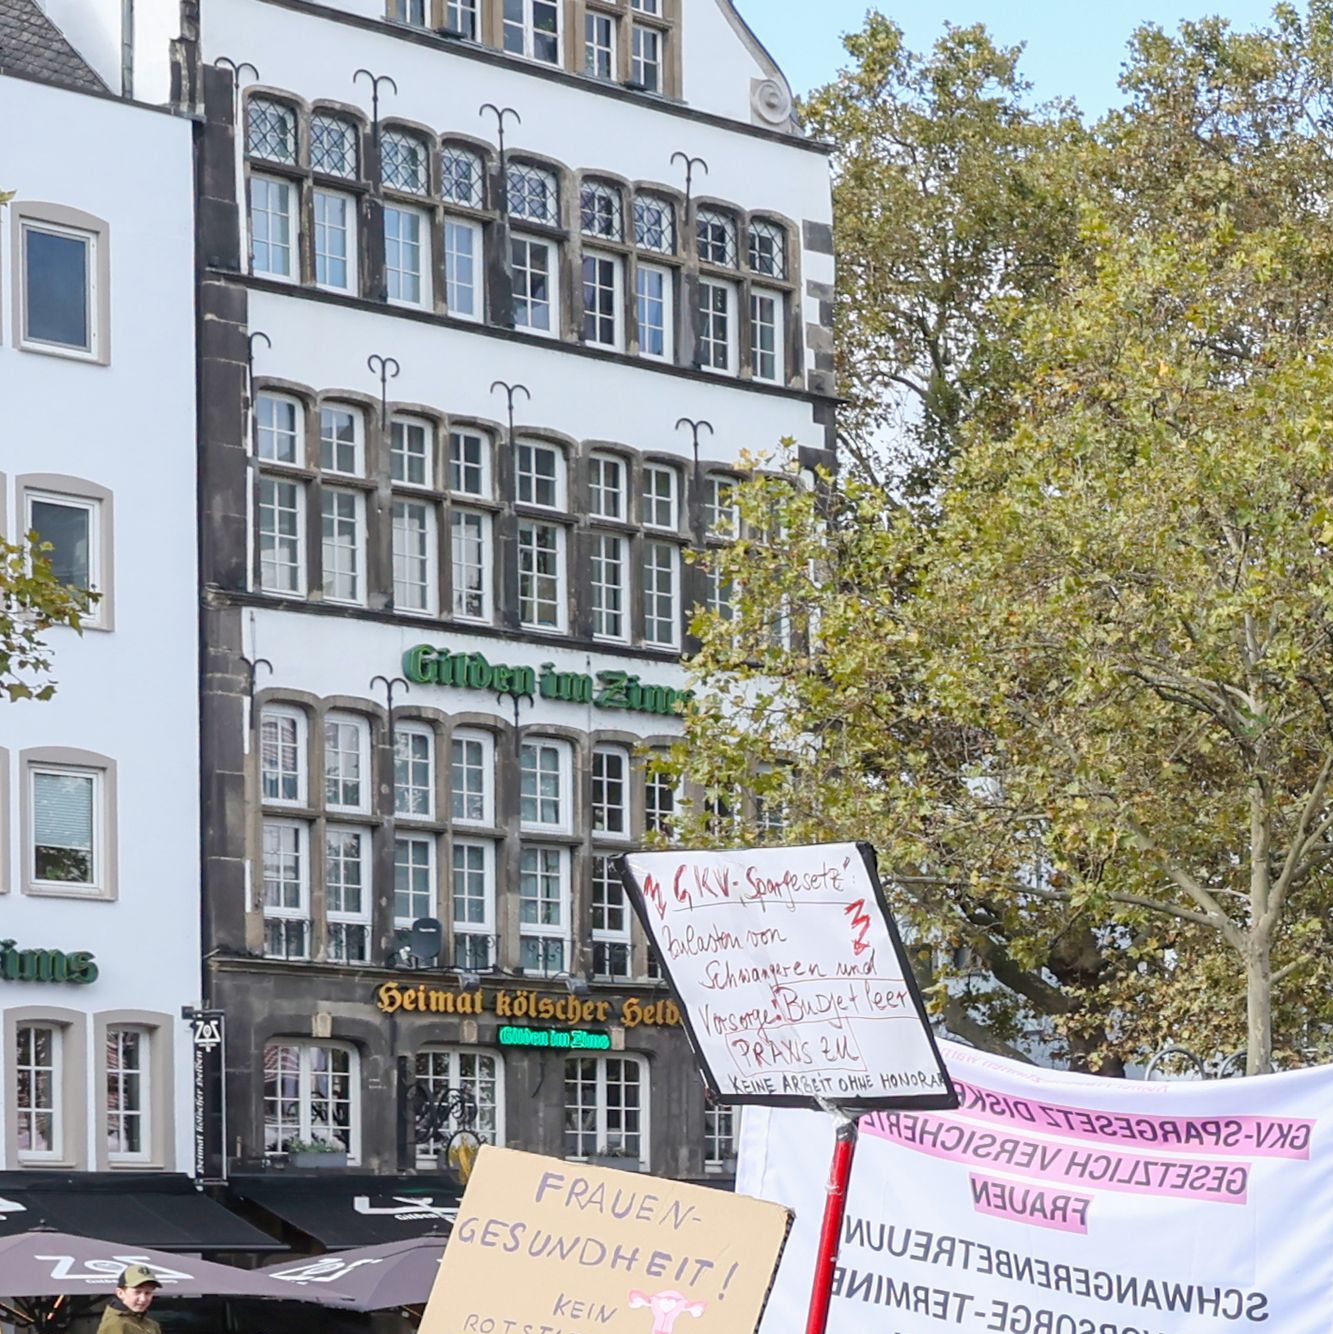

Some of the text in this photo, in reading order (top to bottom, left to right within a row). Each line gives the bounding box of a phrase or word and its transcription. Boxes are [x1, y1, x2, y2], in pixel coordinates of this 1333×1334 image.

[402, 644, 535, 695] Gilden
[539, 662, 593, 703] im
[747, 927, 787, 948] von
[0, 938, 99, 985] ims
[699, 948, 877, 990] Schwangeren und
[377, 981, 684, 1027] Heimat kölscher Held
[865, 979, 908, 1013] leer
[500, 1026, 610, 1049] Gilden im Zims
[728, 1074, 776, 1094] KEINE
[838, 1075, 874, 1091] OHNE
[535, 1171, 702, 1231] FRAUEN-
[458, 1217, 739, 1300] GESUNDHEIT!
[552, 1293, 618, 1323] KEIN
